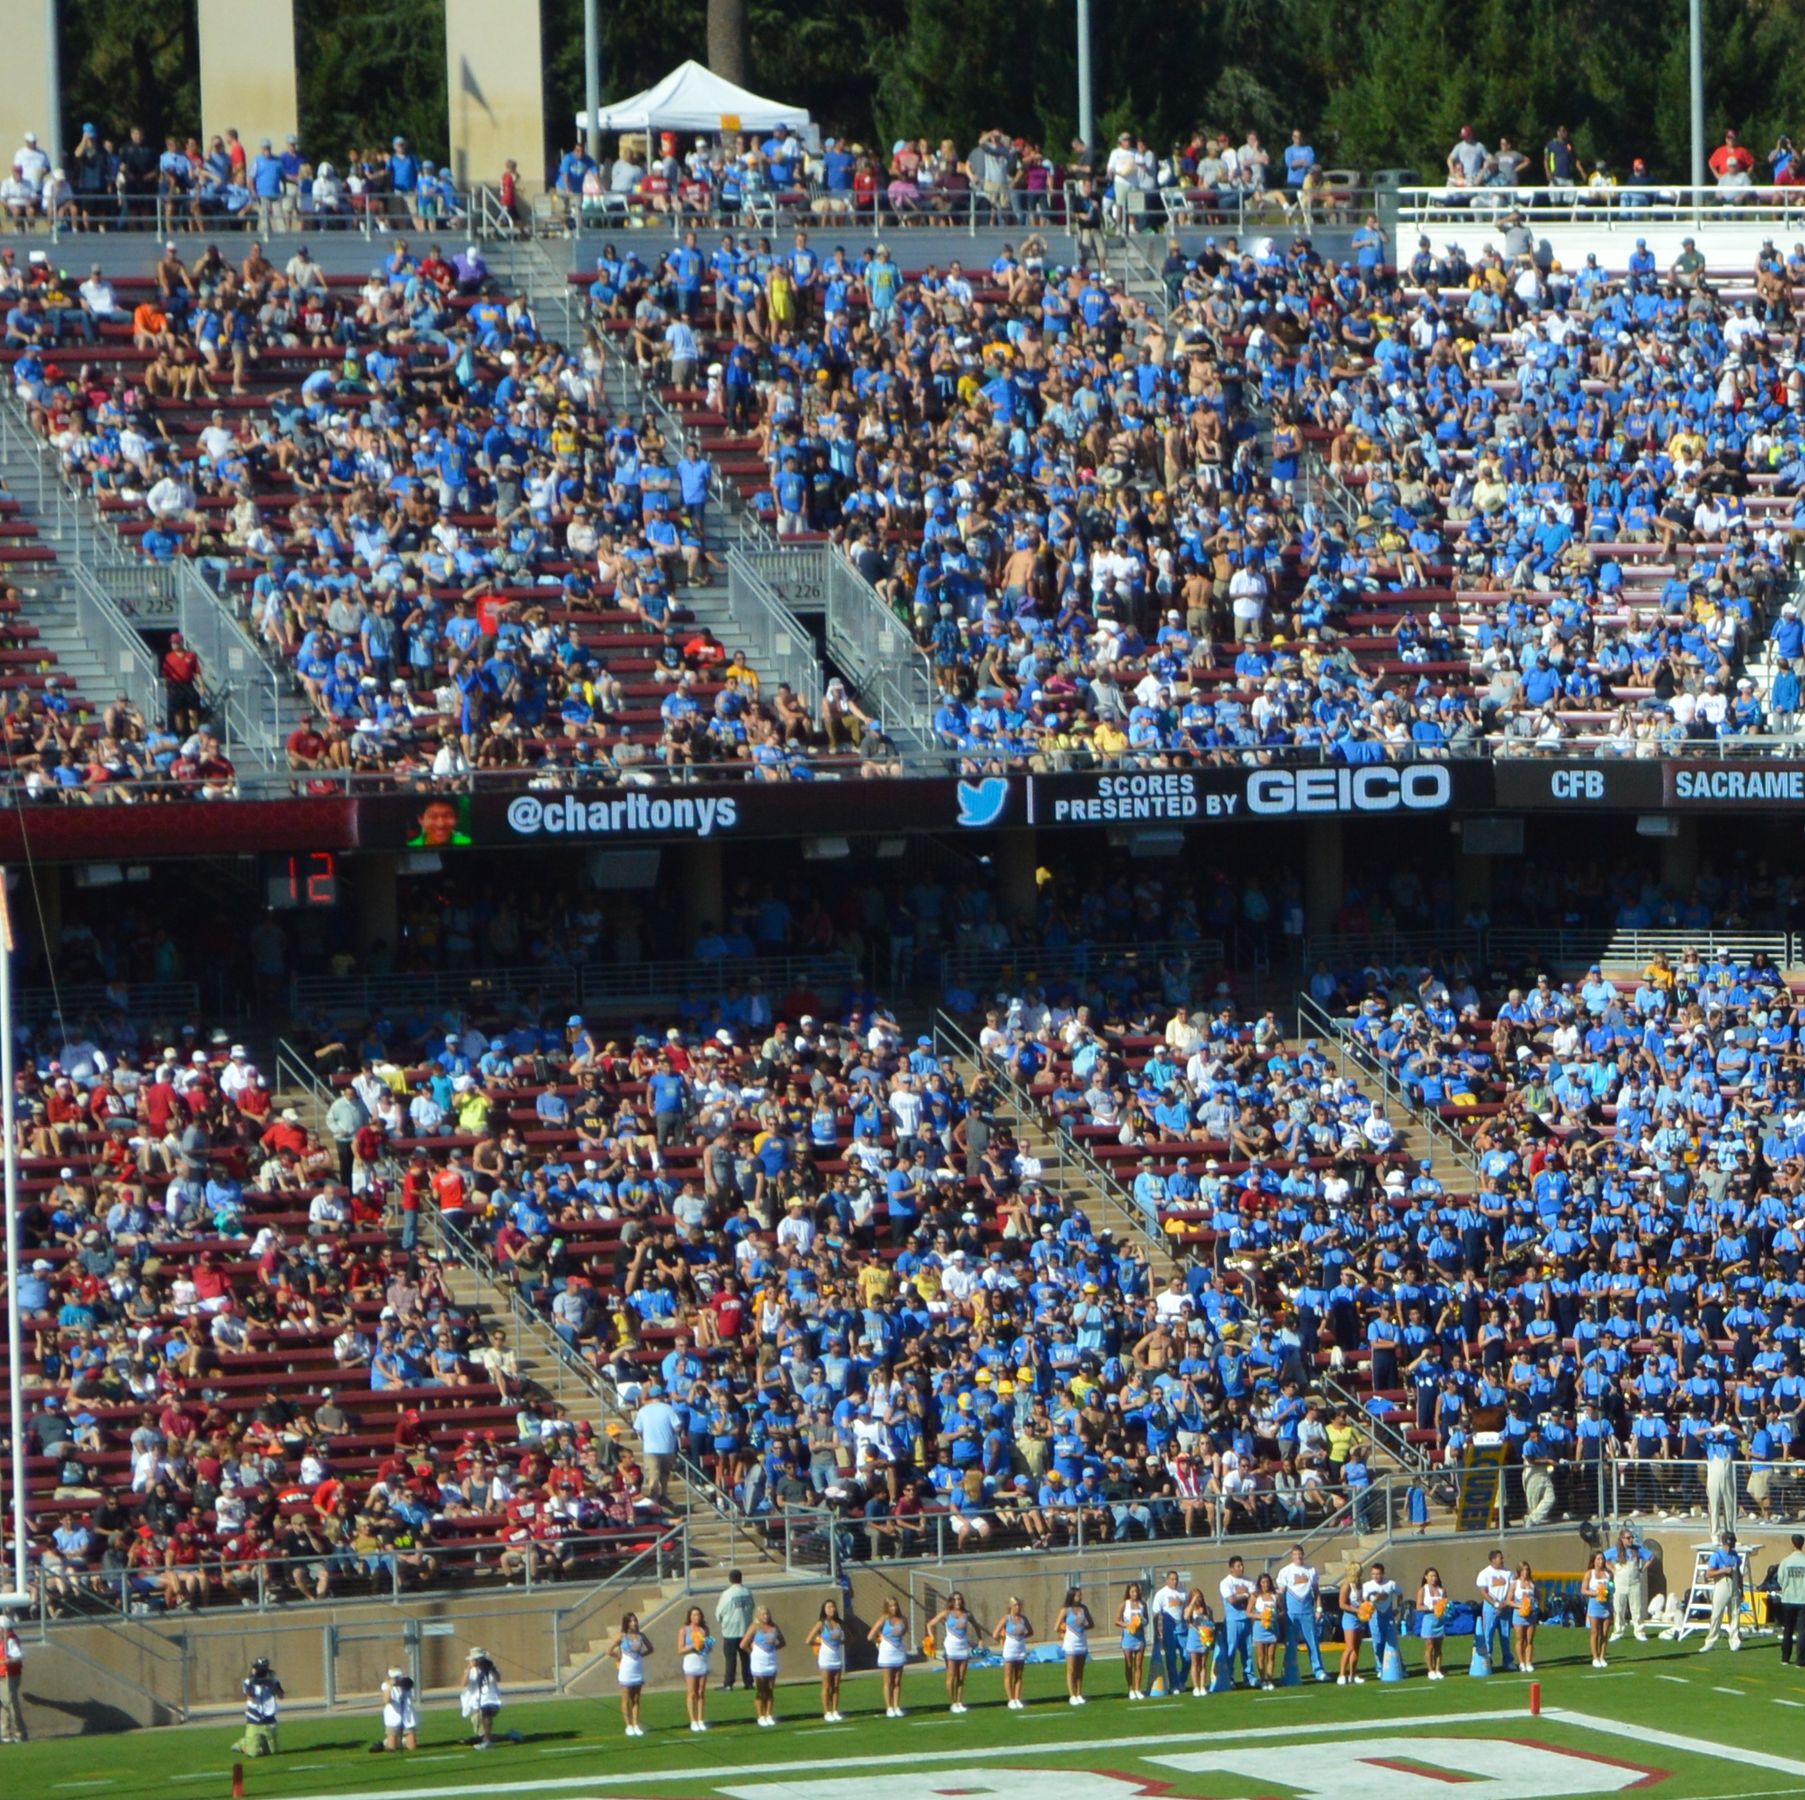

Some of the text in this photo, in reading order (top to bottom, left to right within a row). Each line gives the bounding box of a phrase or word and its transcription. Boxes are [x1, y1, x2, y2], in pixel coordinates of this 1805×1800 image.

[795, 584, 820, 598] 226
[147, 600, 173, 613] 225
[1099, 775, 1193, 796] SCORES
[1247, 766, 1450, 813] GEICO
[1552, 771, 1603, 797] CFB
[508, 792, 735, 836] @charltonys
[1056, 795, 1237, 821] PRESENTED BY
[289, 852, 335, 902] 12
